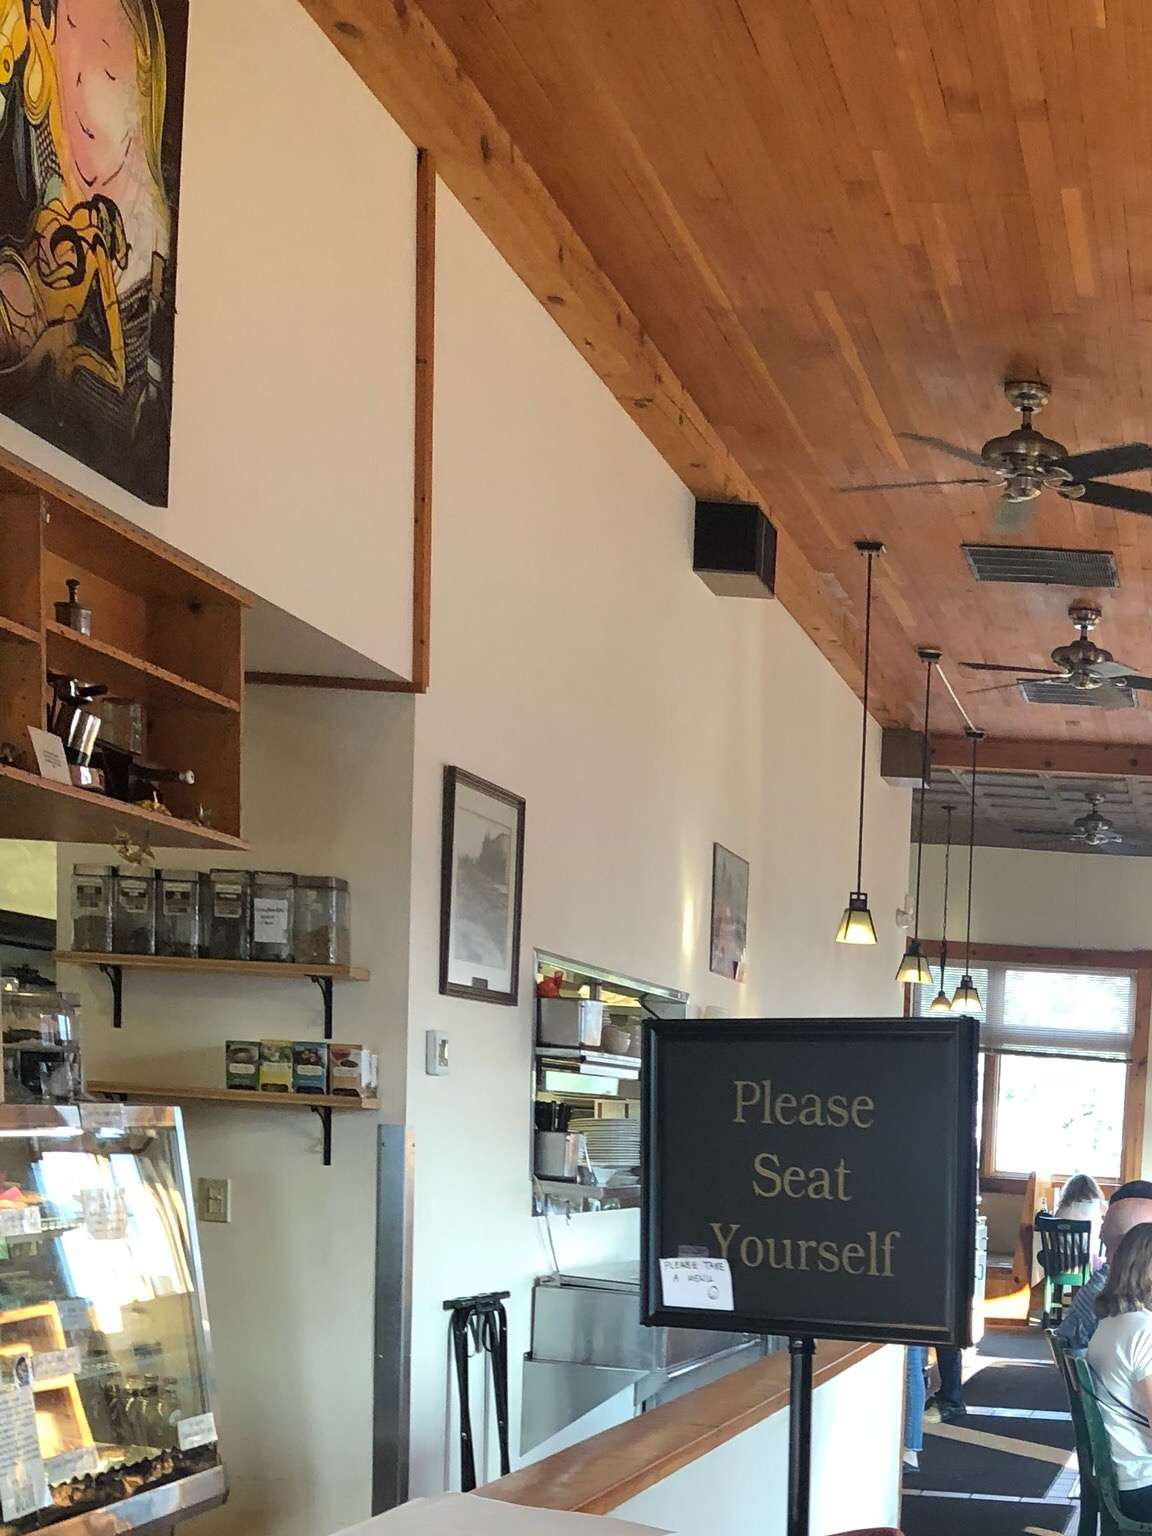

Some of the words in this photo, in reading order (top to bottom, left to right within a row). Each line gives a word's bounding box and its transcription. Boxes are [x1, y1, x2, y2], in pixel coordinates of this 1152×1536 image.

[733, 1079, 875, 1129] Please
[752, 1152, 852, 1201] Seat
[709, 1222, 900, 1278] Yourself
